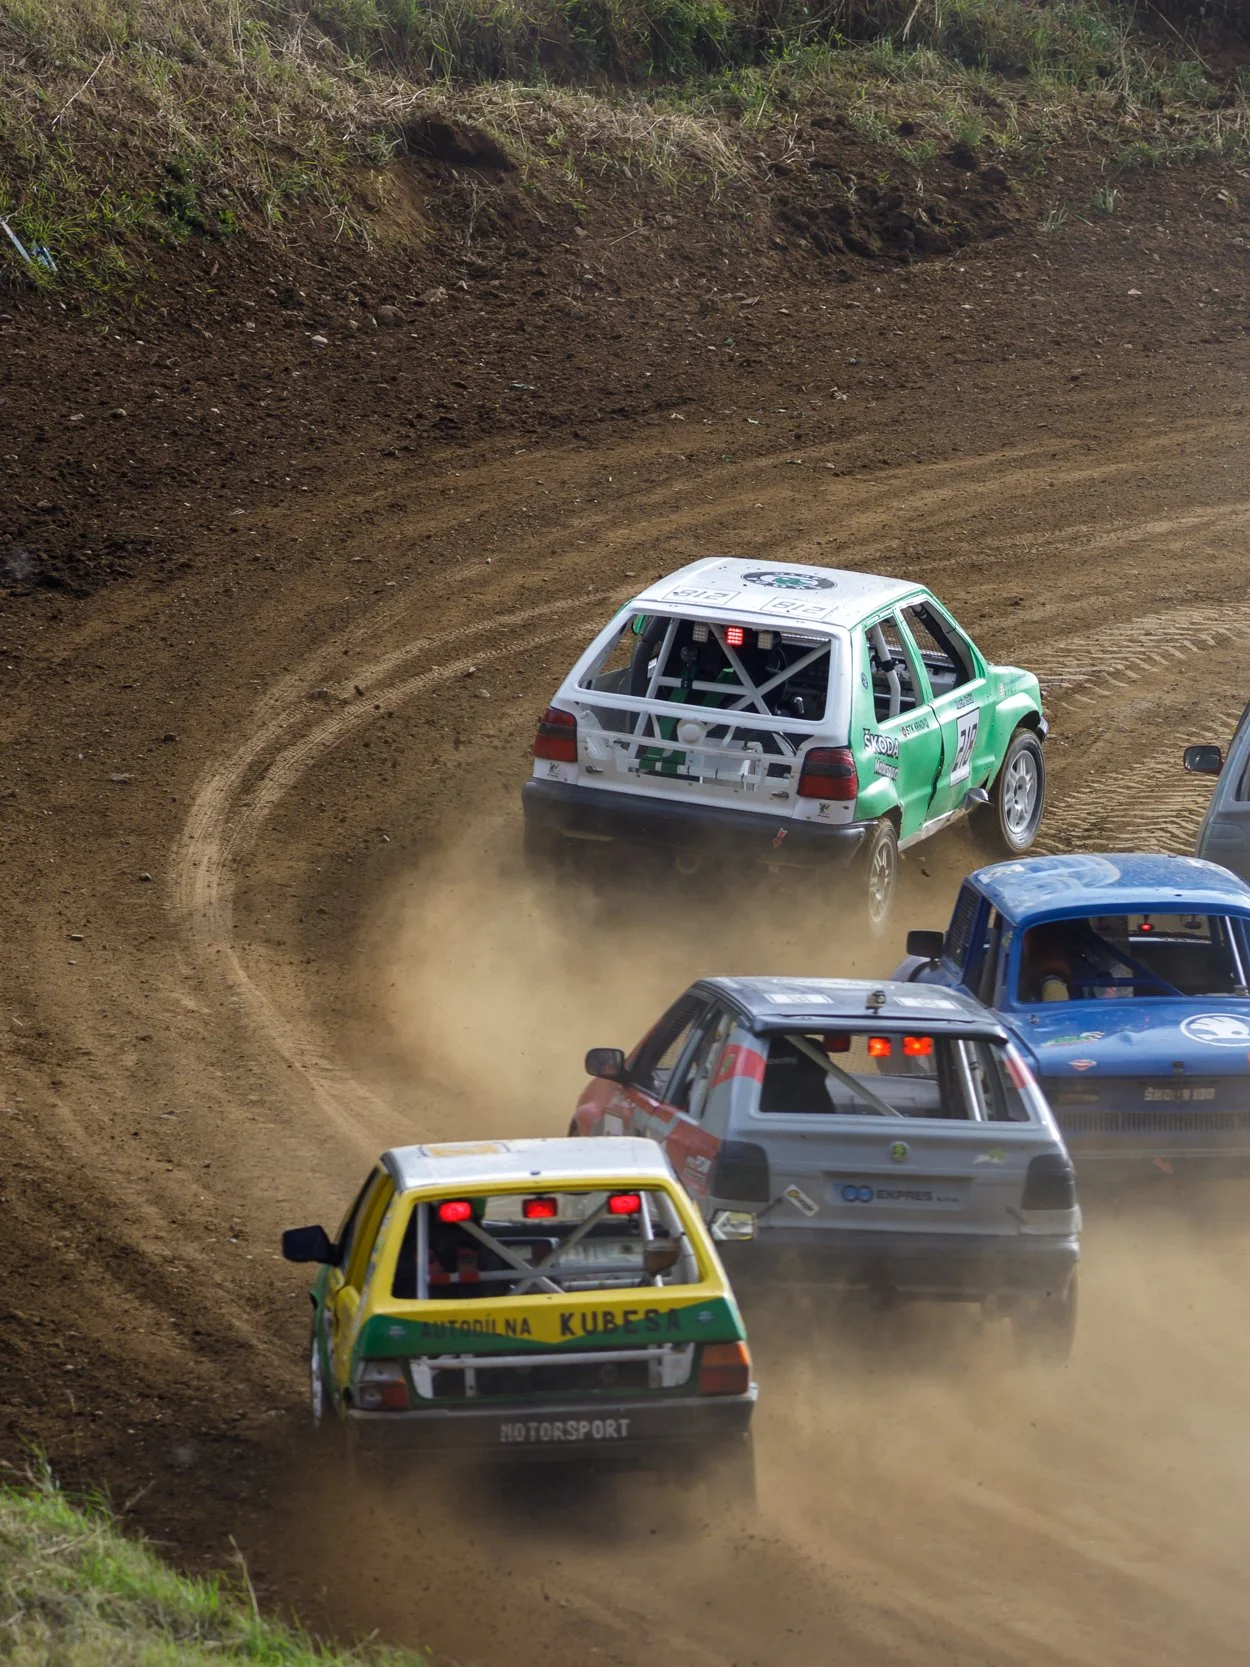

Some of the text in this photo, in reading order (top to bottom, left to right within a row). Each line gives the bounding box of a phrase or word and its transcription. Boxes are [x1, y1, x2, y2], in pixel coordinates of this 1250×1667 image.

[863, 728, 899, 759] ŠKODA
[877, 1189, 933, 1201] EXPRES
[420, 1309, 682, 1340] AUTODÍLNA KUBESA
[500, 1419, 630, 1442] MOTORSPORT
